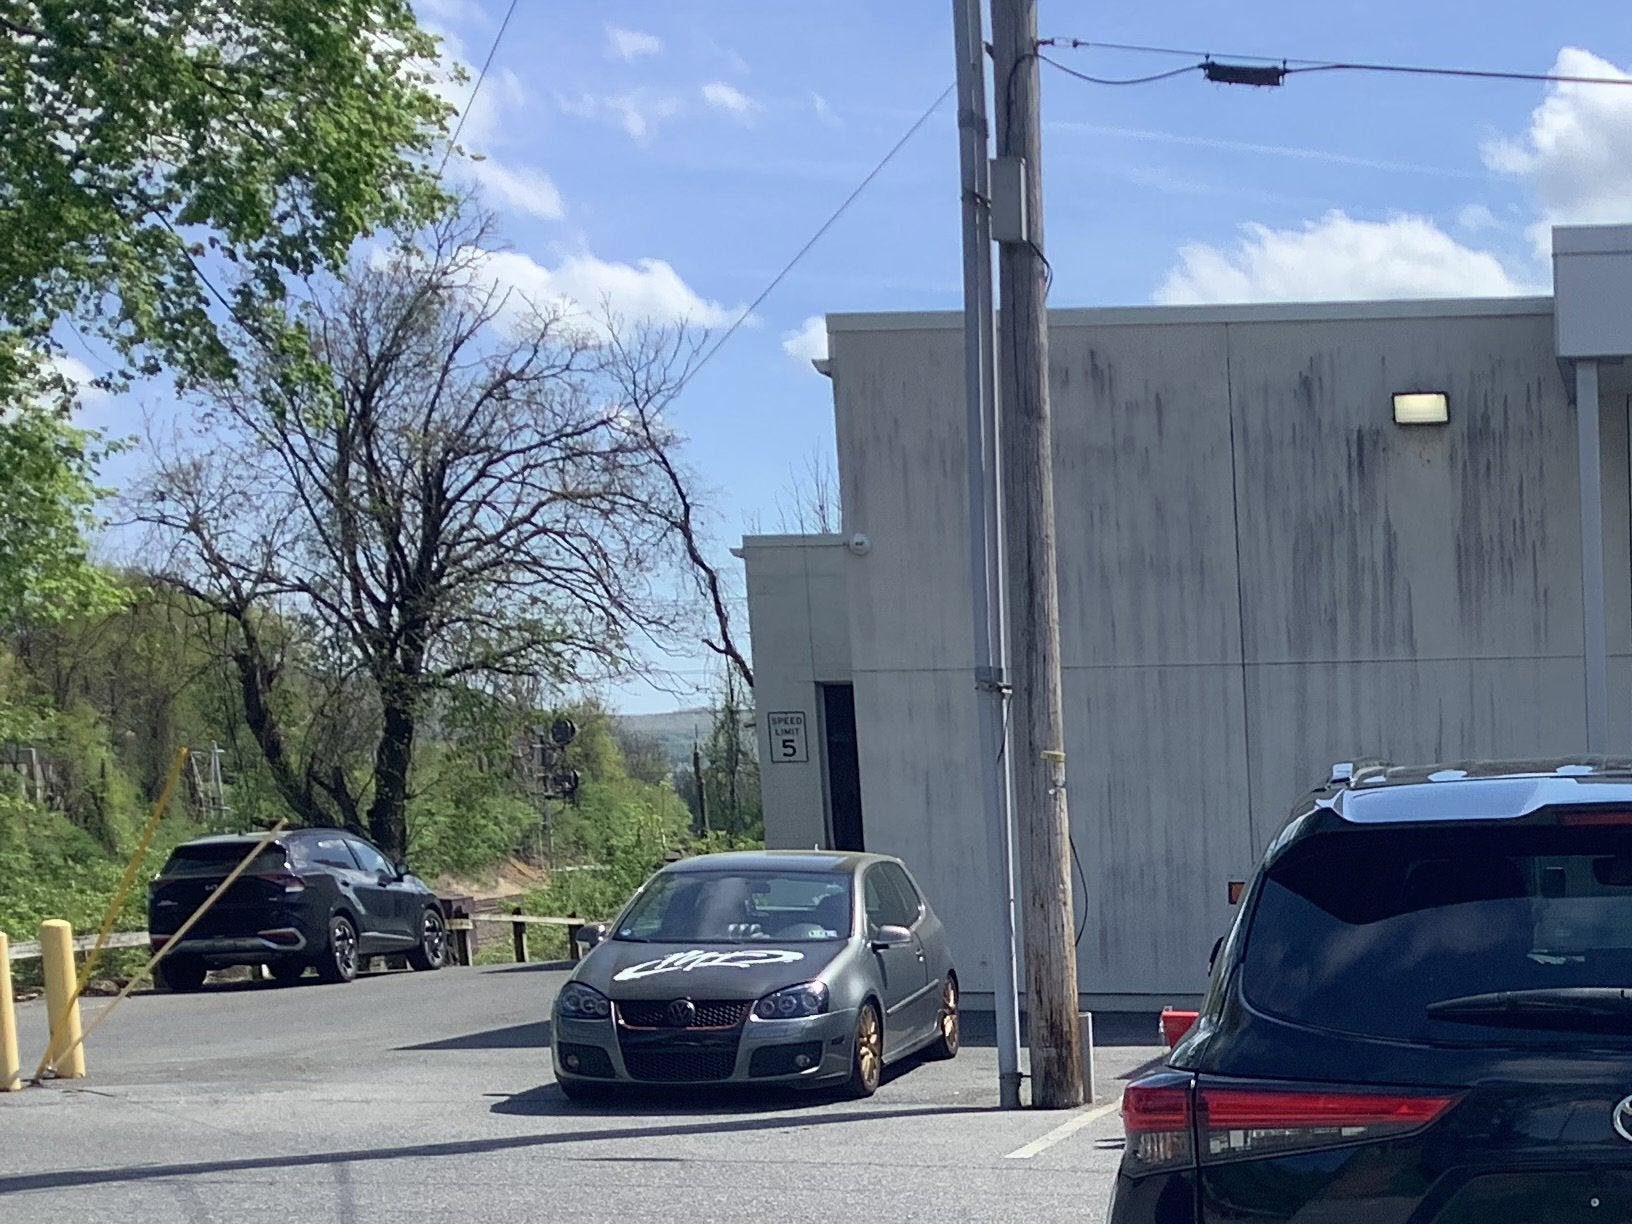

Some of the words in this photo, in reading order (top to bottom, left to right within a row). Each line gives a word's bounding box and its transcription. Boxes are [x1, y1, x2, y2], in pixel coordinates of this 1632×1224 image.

[771, 716, 802, 725] SPEED
[775, 727, 800, 736] LIMIT
[782, 738, 797, 757] 5
